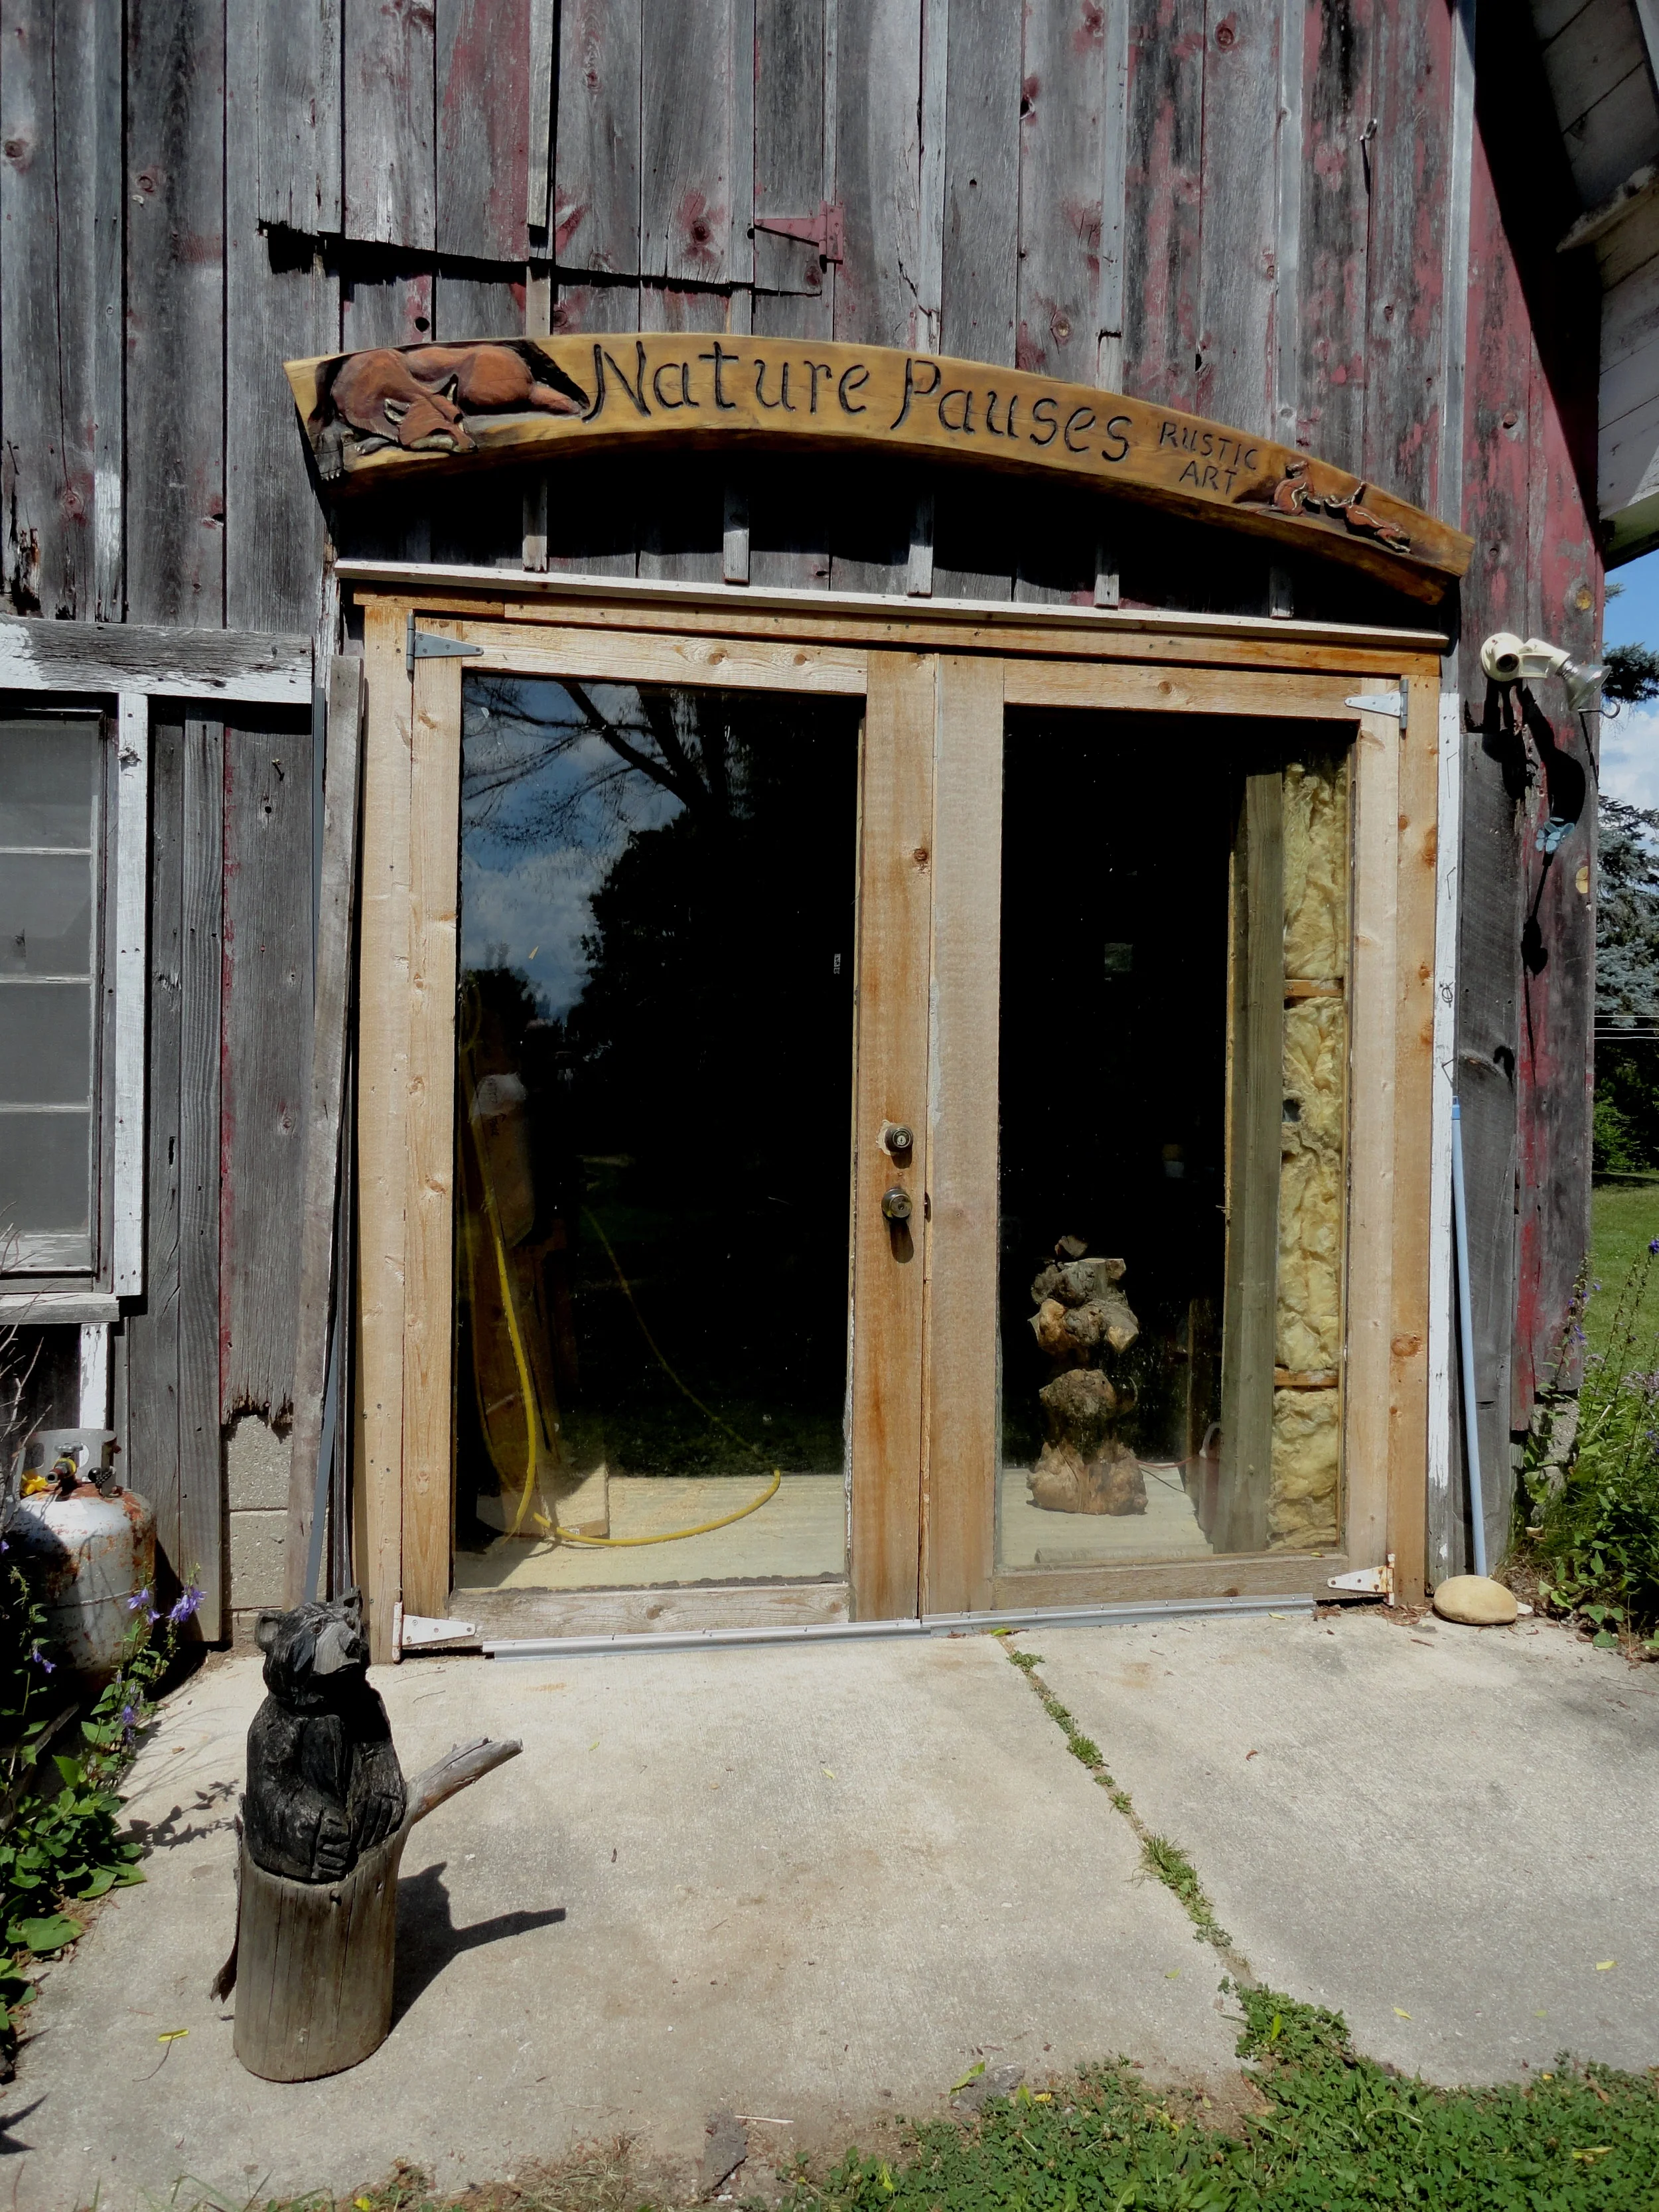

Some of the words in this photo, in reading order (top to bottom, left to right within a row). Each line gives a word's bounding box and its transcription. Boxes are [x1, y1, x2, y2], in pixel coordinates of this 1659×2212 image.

[581, 340, 870, 422] Nature
[890, 357, 1133, 463] Pauses
[1159, 421, 1259, 471] RUSTIC
[1179, 459, 1238, 495] ART
